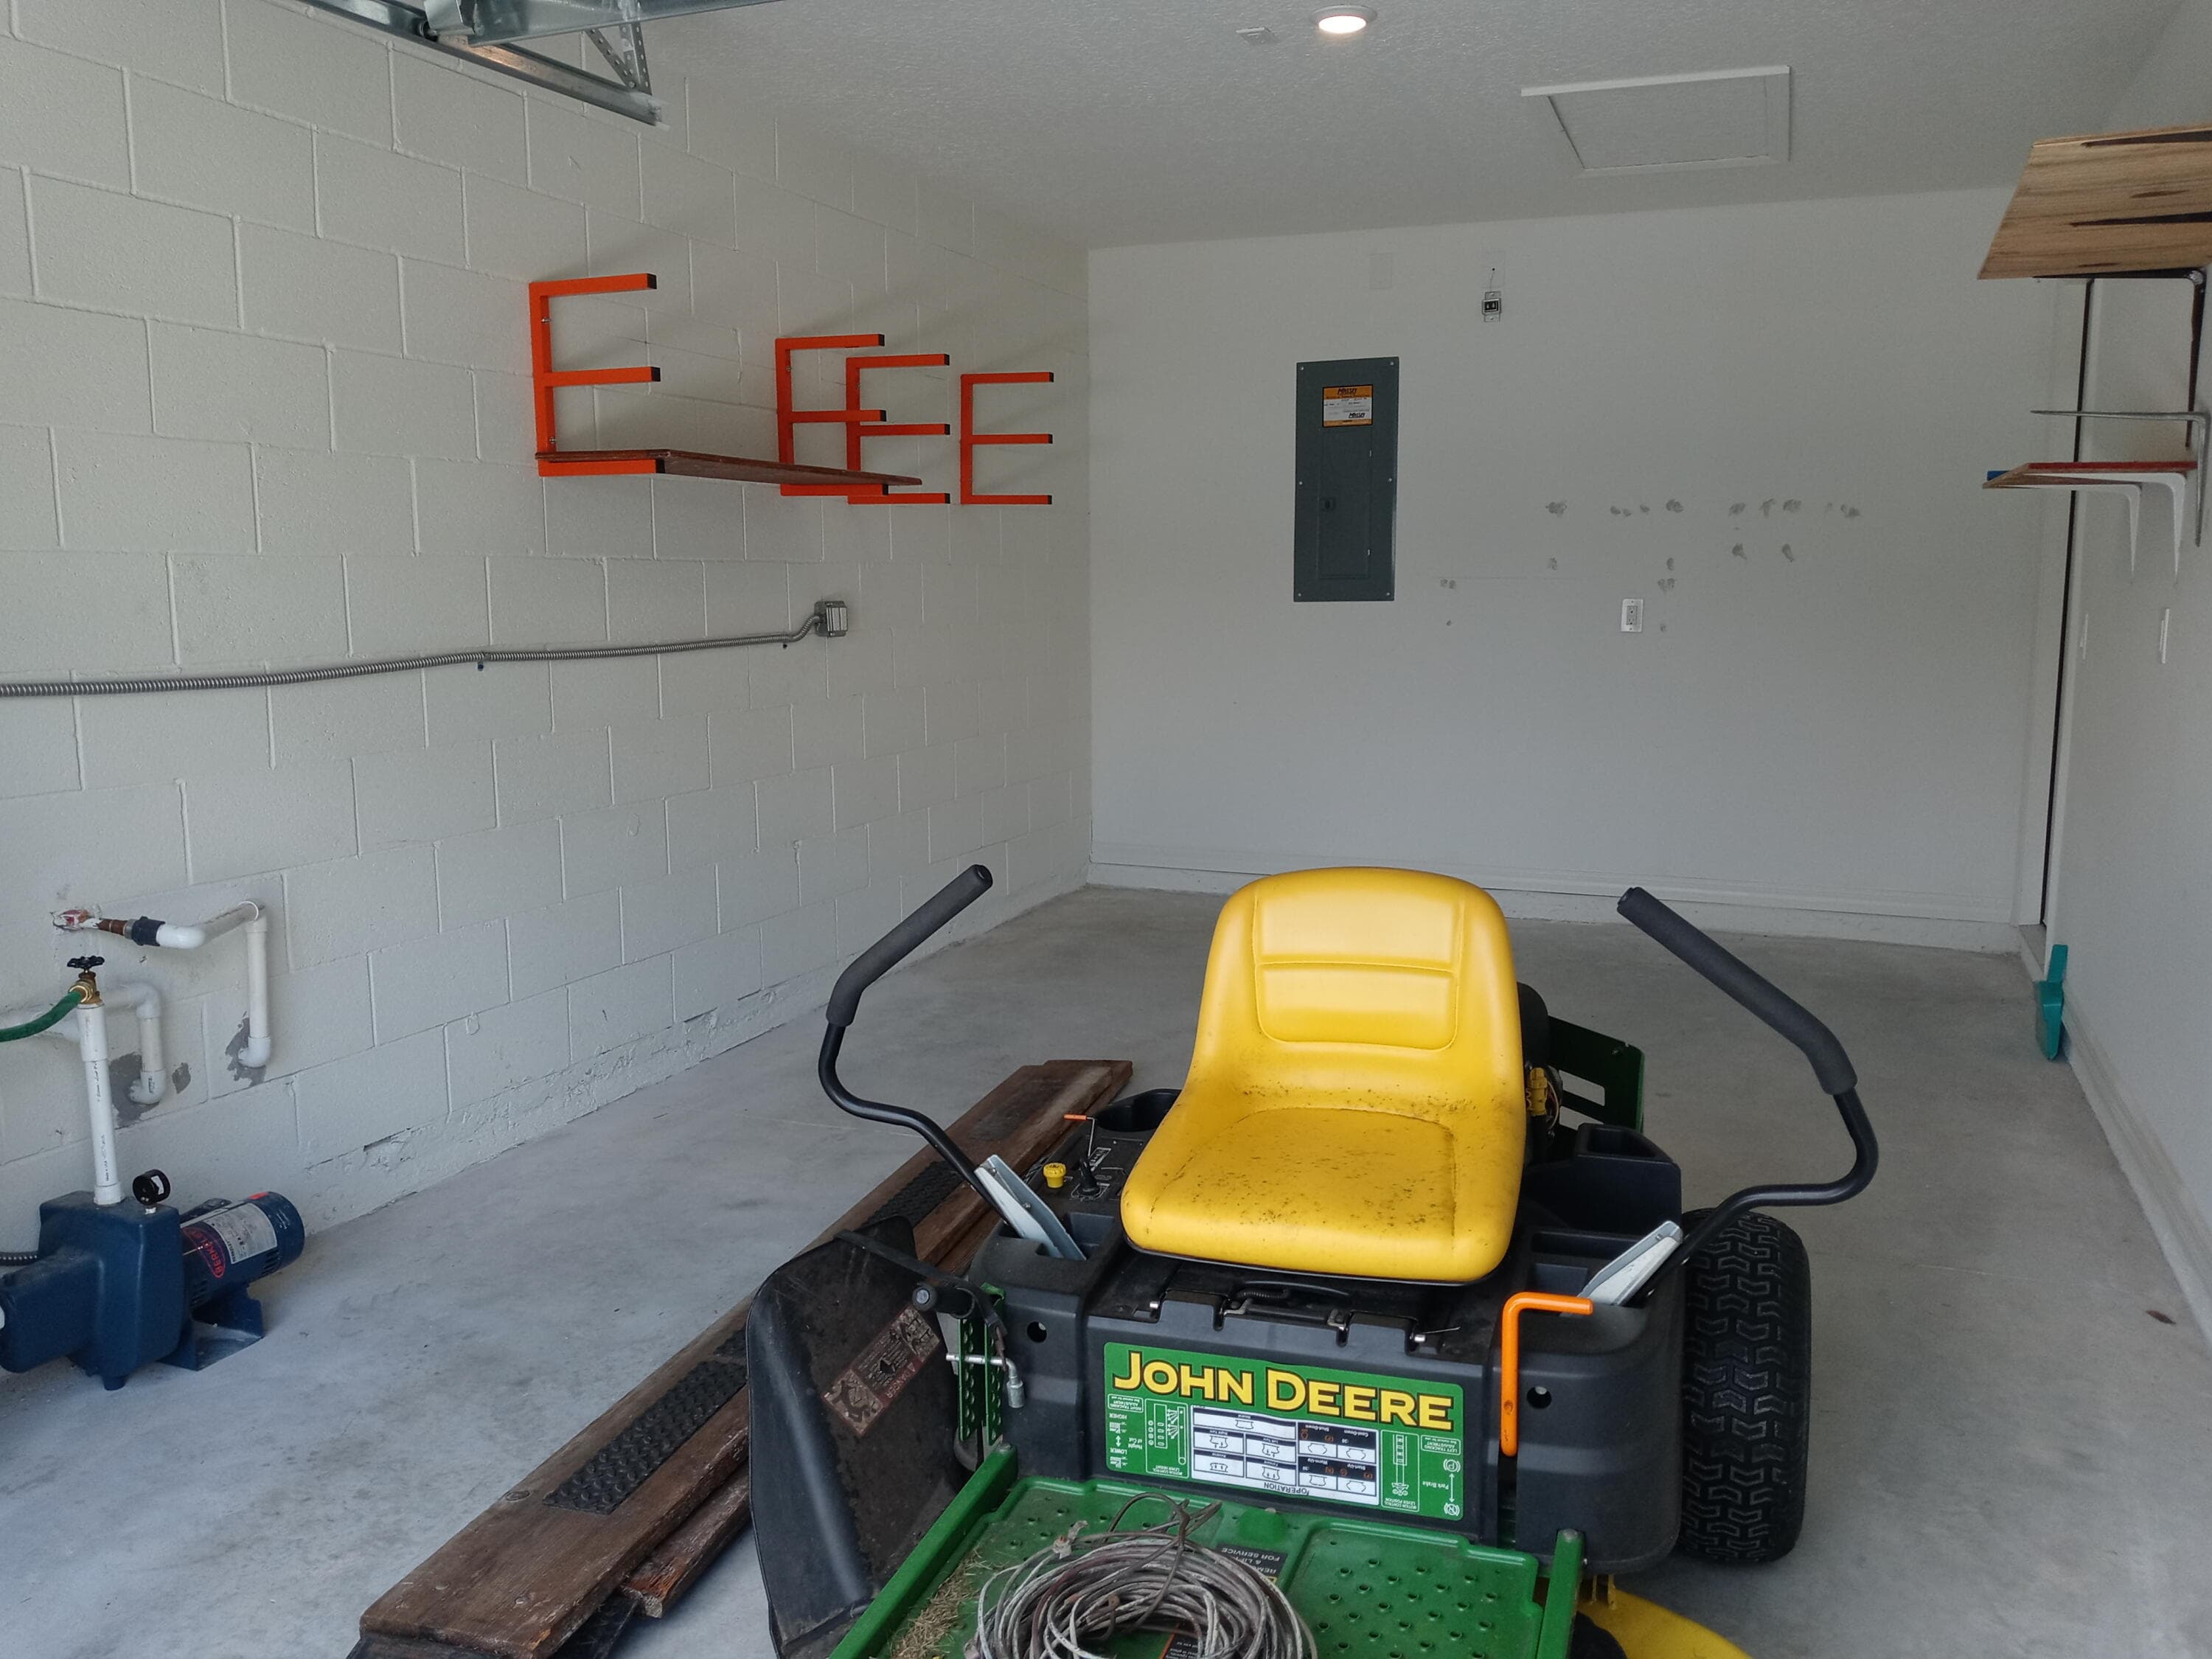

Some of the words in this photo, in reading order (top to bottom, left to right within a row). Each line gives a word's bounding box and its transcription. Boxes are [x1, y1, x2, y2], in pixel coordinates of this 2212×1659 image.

[1113, 1351, 1254, 1405] JOHN
[1266, 1367, 1454, 1431] DEERE
[1264, 1482, 1307, 1495] OPERATION
[1221, 1548, 1259, 1558] SERVICE
